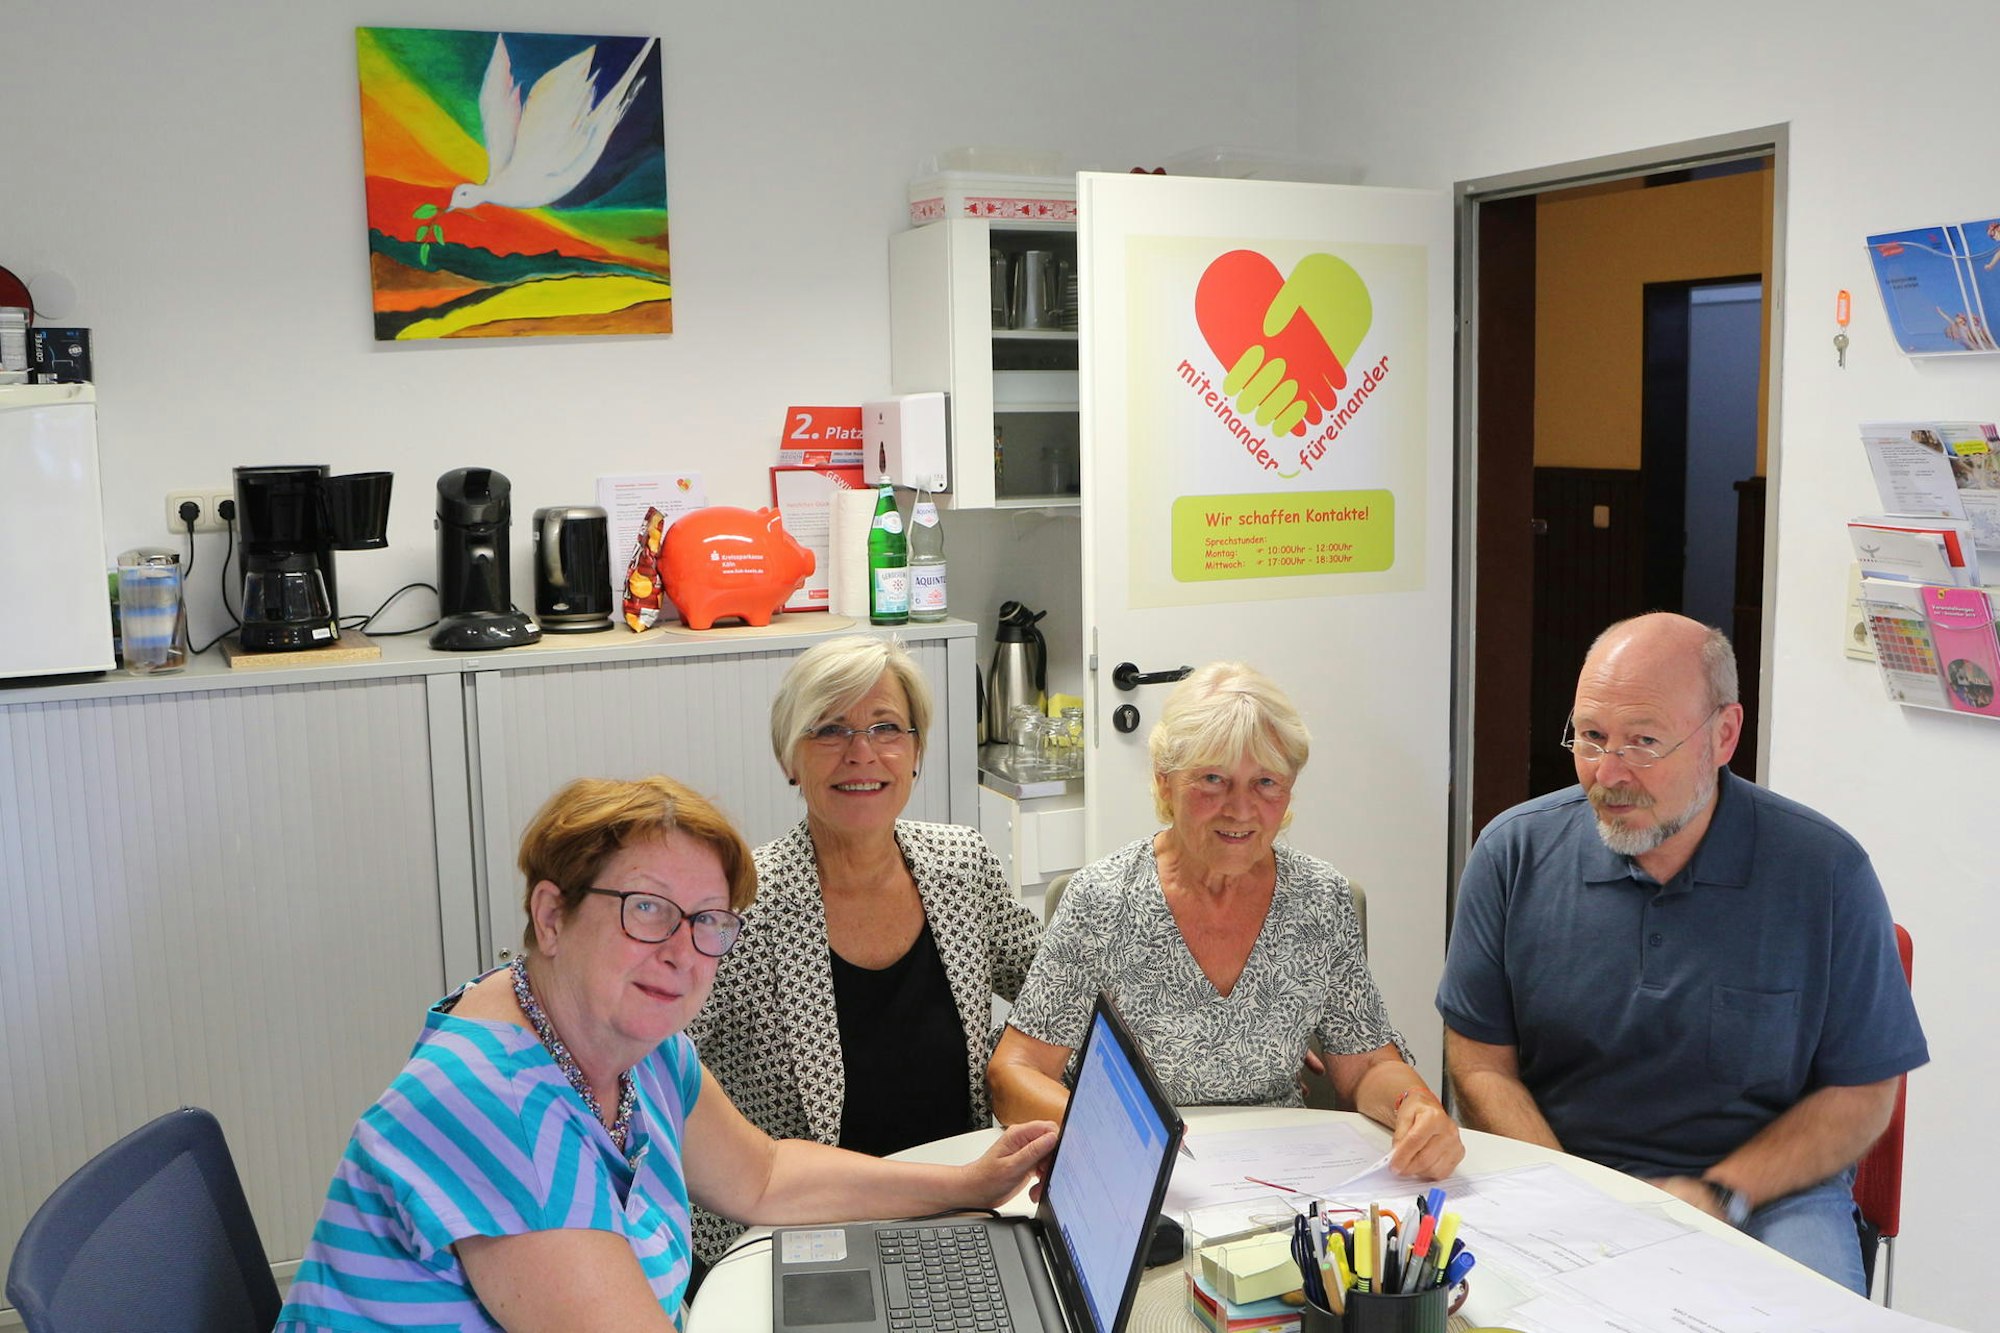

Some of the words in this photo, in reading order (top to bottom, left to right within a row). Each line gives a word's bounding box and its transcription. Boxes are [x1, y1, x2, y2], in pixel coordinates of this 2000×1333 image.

[34, 331, 44, 362] COFFEE
[1176, 359, 1279, 470] miteinander
[1299, 355, 1389, 471] füreinander
[790, 413, 820, 439] 2.
[825, 426, 864, 439] Platz
[1205, 512, 1232, 527] Wir
[1238, 509, 1300, 525] schaffen
[1306, 506, 1369, 523] Kontakte!
[1204, 536, 1268, 547] Sprechstunden:
[1204, 550, 1238, 559] Montag:
[1268, 545, 1305, 555] 10:00Uhr
[1316, 543, 1352, 552] 12:00Uhr
[1204, 560, 1246, 570] Mittwoch:
[1268, 557, 1305, 566] 17:00Uhr
[1316, 555, 1352, 564] 18:30Uhr
